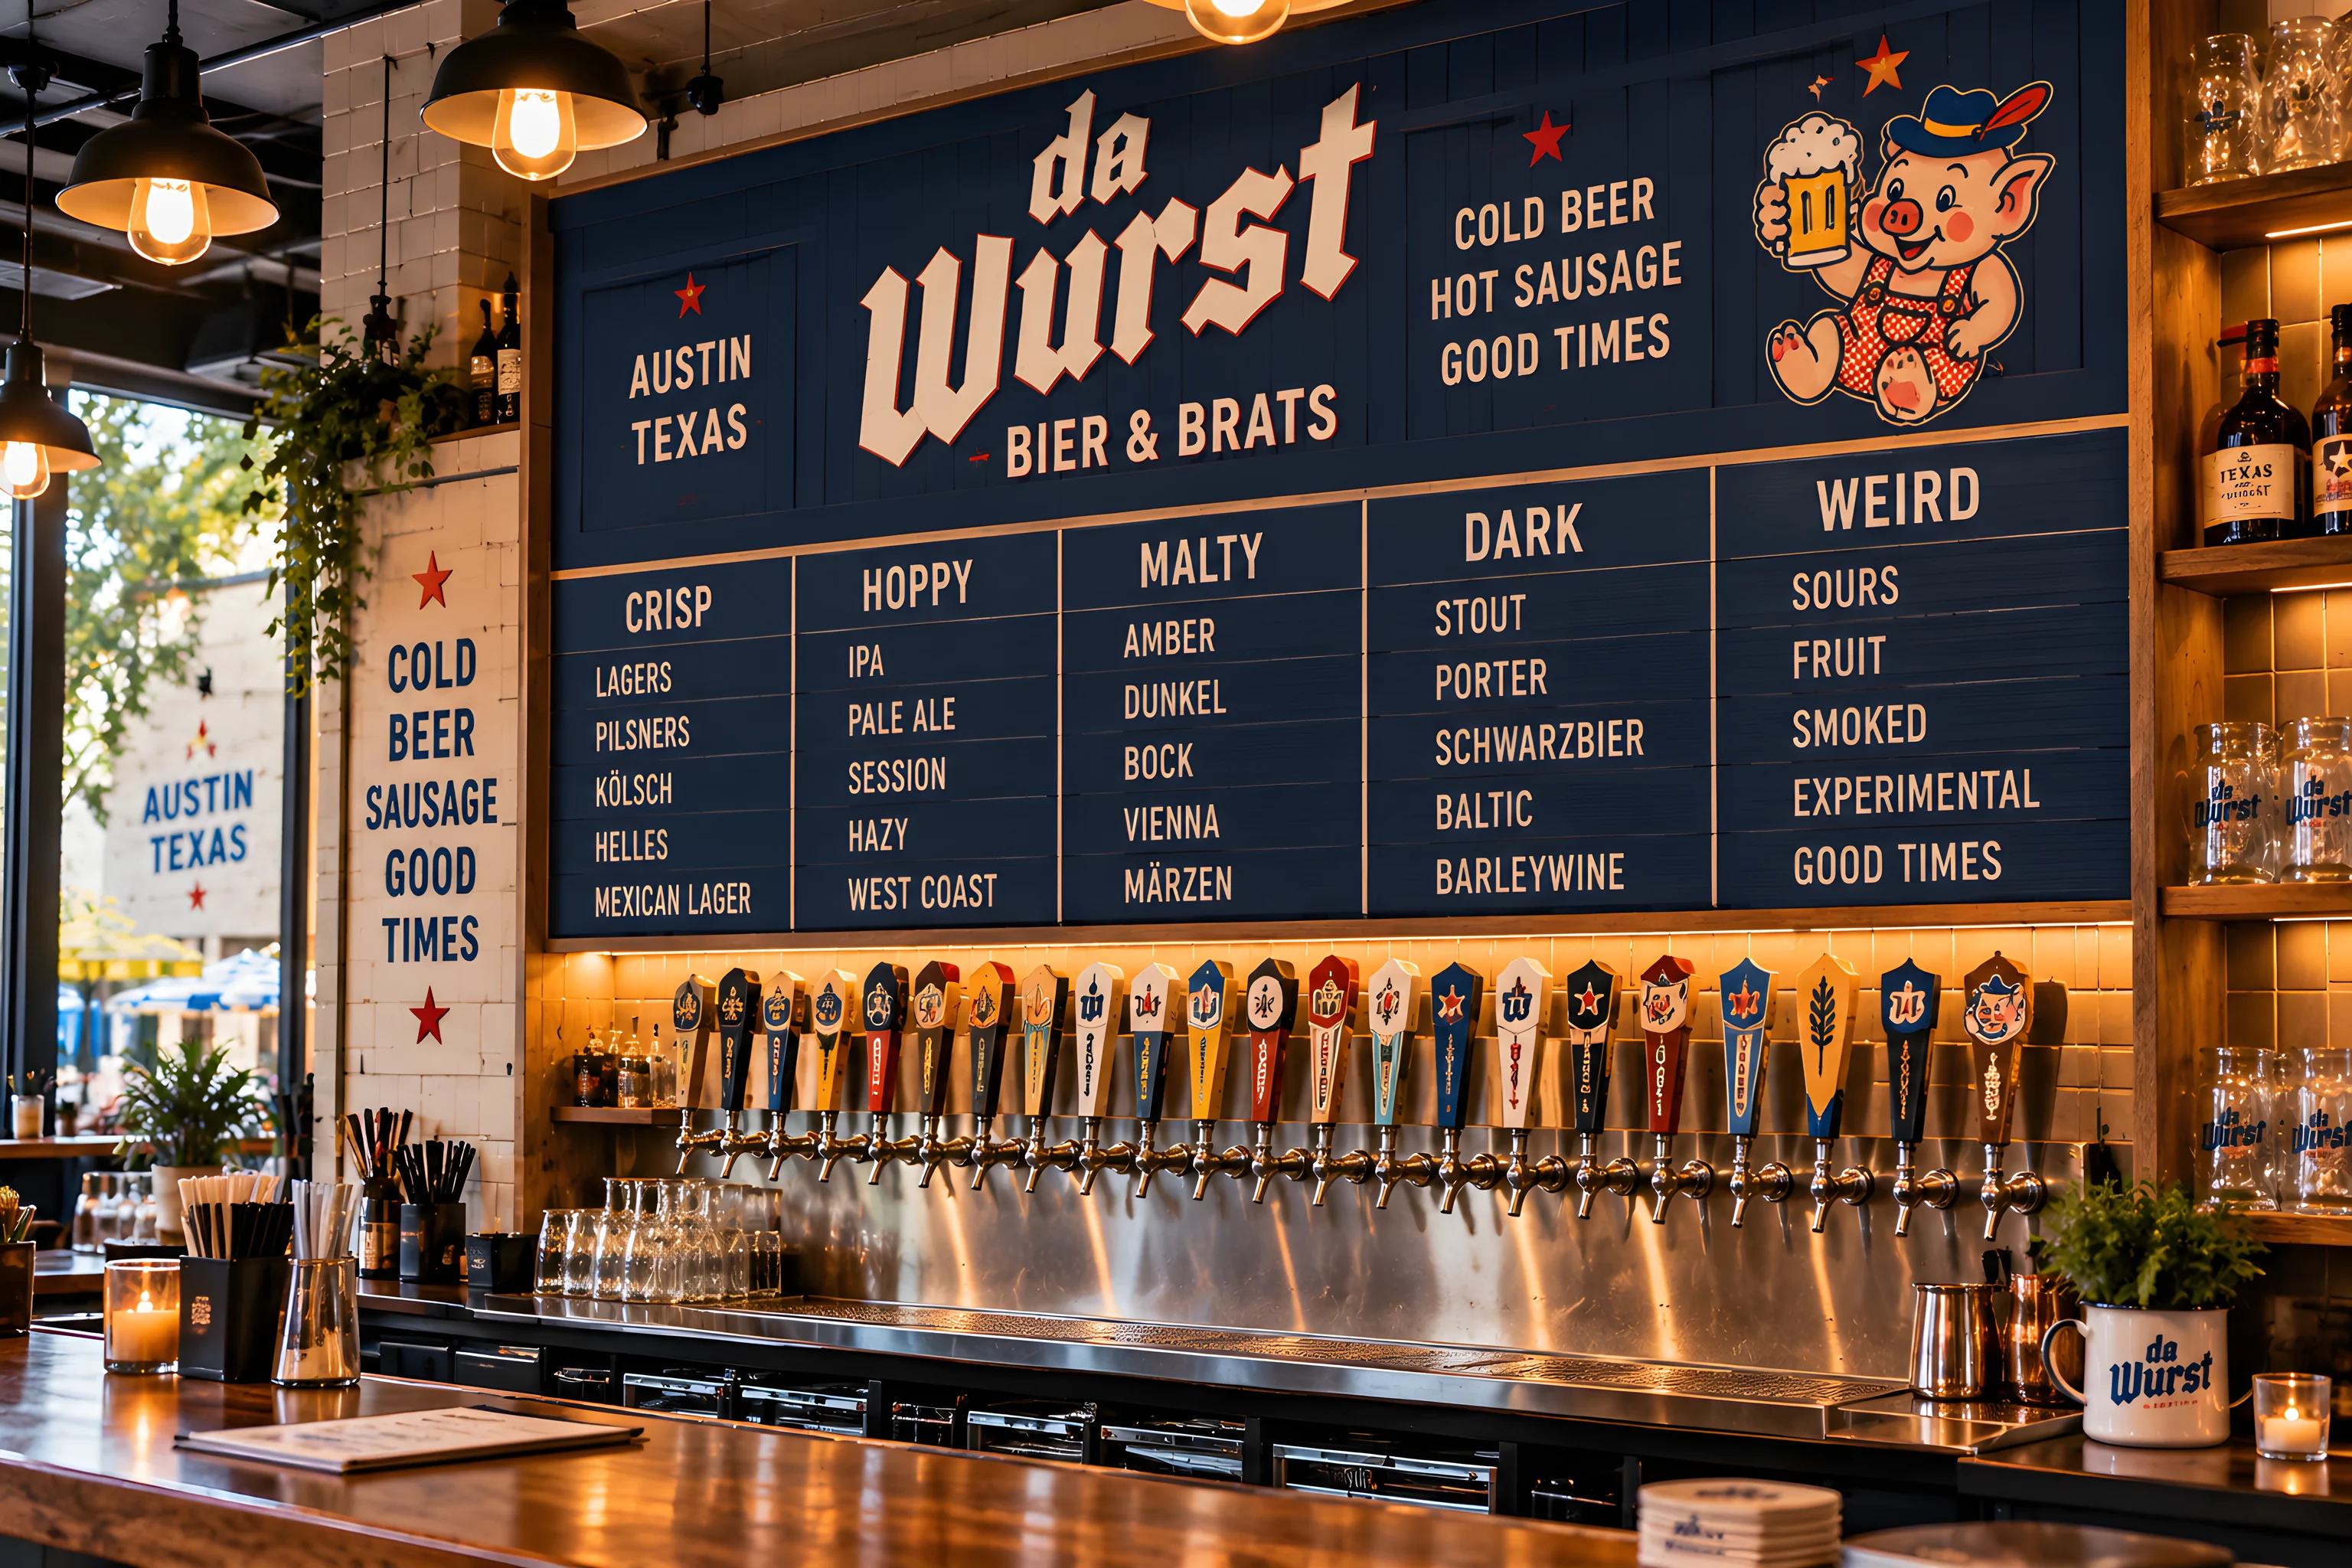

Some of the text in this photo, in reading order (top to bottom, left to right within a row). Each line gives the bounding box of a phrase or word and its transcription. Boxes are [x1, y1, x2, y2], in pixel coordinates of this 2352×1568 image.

[1028, 87, 1151, 226] da
[1455, 177, 1655, 250] COLD BEER
[858, 81, 1377, 469] Wurst
[1432, 240, 1682, 321] HOT SAUSAGE
[629, 334, 750, 400] AUSTIN
[1441, 312, 1670, 386] GOOD TIMES
[631, 403, 747, 466] TEXAS
[1007, 384, 1336, 479] BIER & BRATS
[1816, 466, 1980, 531] WEIRD
[1465, 502, 1584, 562] DARK
[1141, 531, 1263, 589] MALTY
[863, 559, 973, 612] HOPPY
[1792, 565, 1899, 611] SOURS
[626, 585, 712, 633] CRISP
[1435, 593, 1527, 636] STOUT
[849, 644, 884, 678] IPA
[1123, 618, 1215, 658] AMBER
[1793, 635, 1886, 679] FRUIT
[388, 638, 477, 693] COLD
[596, 661, 672, 697] LAGERS
[1436, 658, 1547, 701] PORTER
[848, 697, 956, 737] PALE ALE
[1125, 679, 1227, 720] DUNKEL
[388, 707, 475, 762] BEER
[596, 715, 690, 752] PILSNERS
[1436, 718, 1645, 766] SCHWARZBIER
[1792, 704, 1926, 749] SMOKED
[848, 756, 946, 795] SESSION
[1125, 742, 1194, 781] BOCK
[143, 769, 253, 825] AUSTIN
[366, 778, 498, 830] SAUSAGE
[596, 769, 672, 808] KÖLSCH
[1436, 789, 1533, 830] BALTIC
[1794, 768, 2040, 817] EXPERIMENTAL
[849, 817, 909, 852] HAZY
[1123, 803, 1220, 841] VIENNA
[150, 824, 247, 874] TEXAS
[596, 828, 668, 863] HELLES
[1794, 840, 2002, 886] GOOD TIMES
[385, 846, 476, 897] GOOD
[848, 873, 998, 911] WEST COAST
[1125, 861, 1232, 903] MÄRZEN
[1436, 852, 1625, 895] BARLEYWINE
[595, 882, 751, 918] MEXICAN LAGER
[382, 914, 479, 963] TIMES
[2145, 1334, 2177, 1364] da
[2109, 1351, 2213, 1406] Wurst
